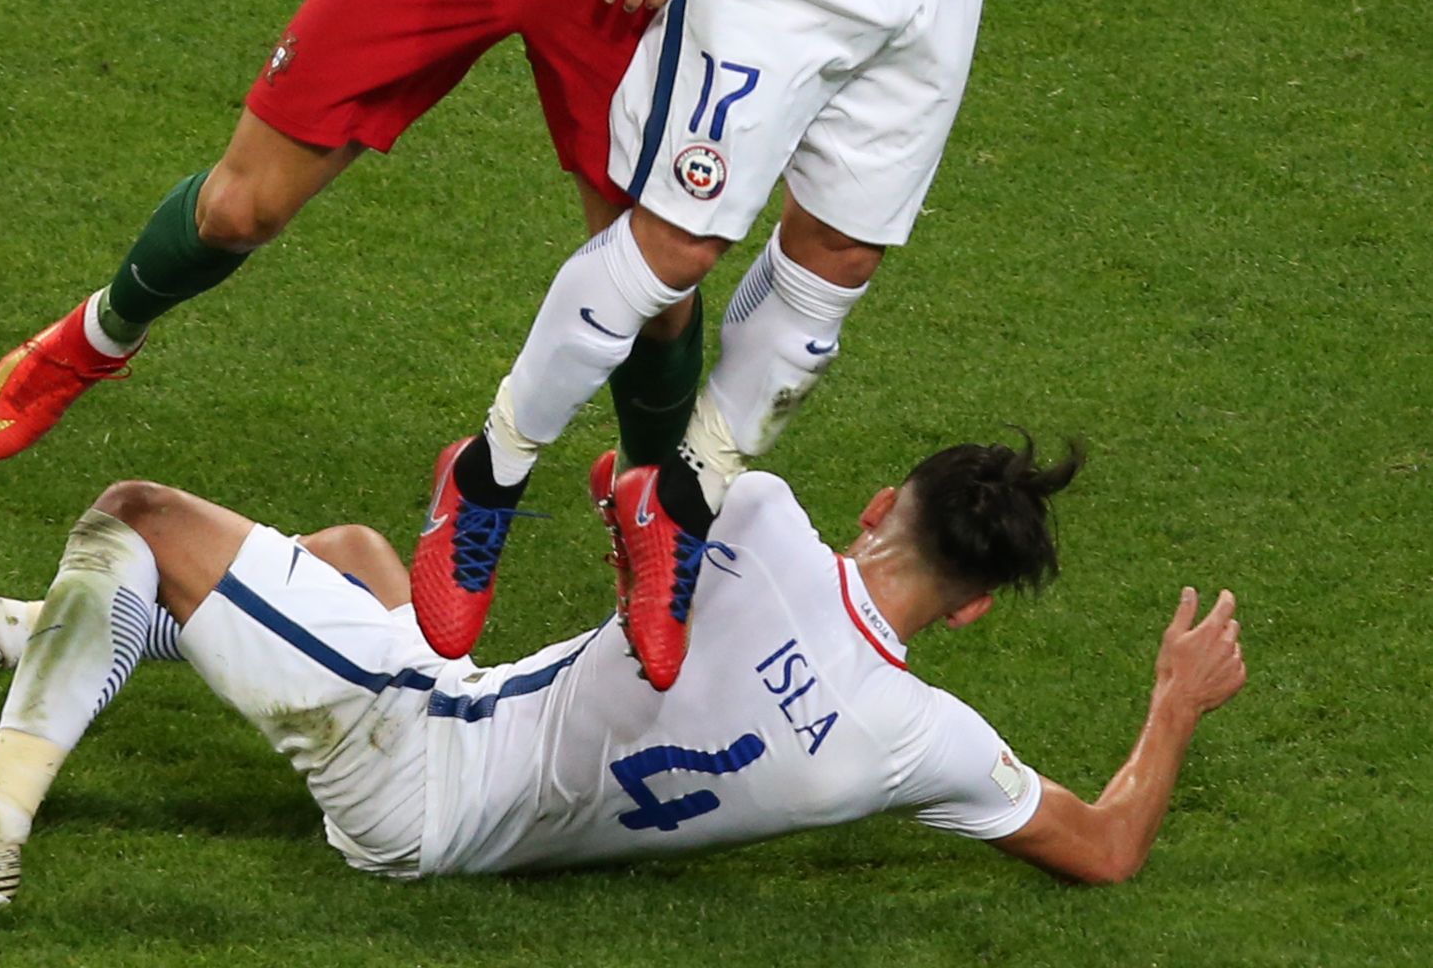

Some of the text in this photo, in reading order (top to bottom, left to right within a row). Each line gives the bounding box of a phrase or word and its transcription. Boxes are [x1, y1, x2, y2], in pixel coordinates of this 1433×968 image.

[689, 50, 760, 142] 17
[860, 601, 890, 639] LA ROJA
[755, 638, 839, 756] ISLA
[610, 733, 765, 831] 4
